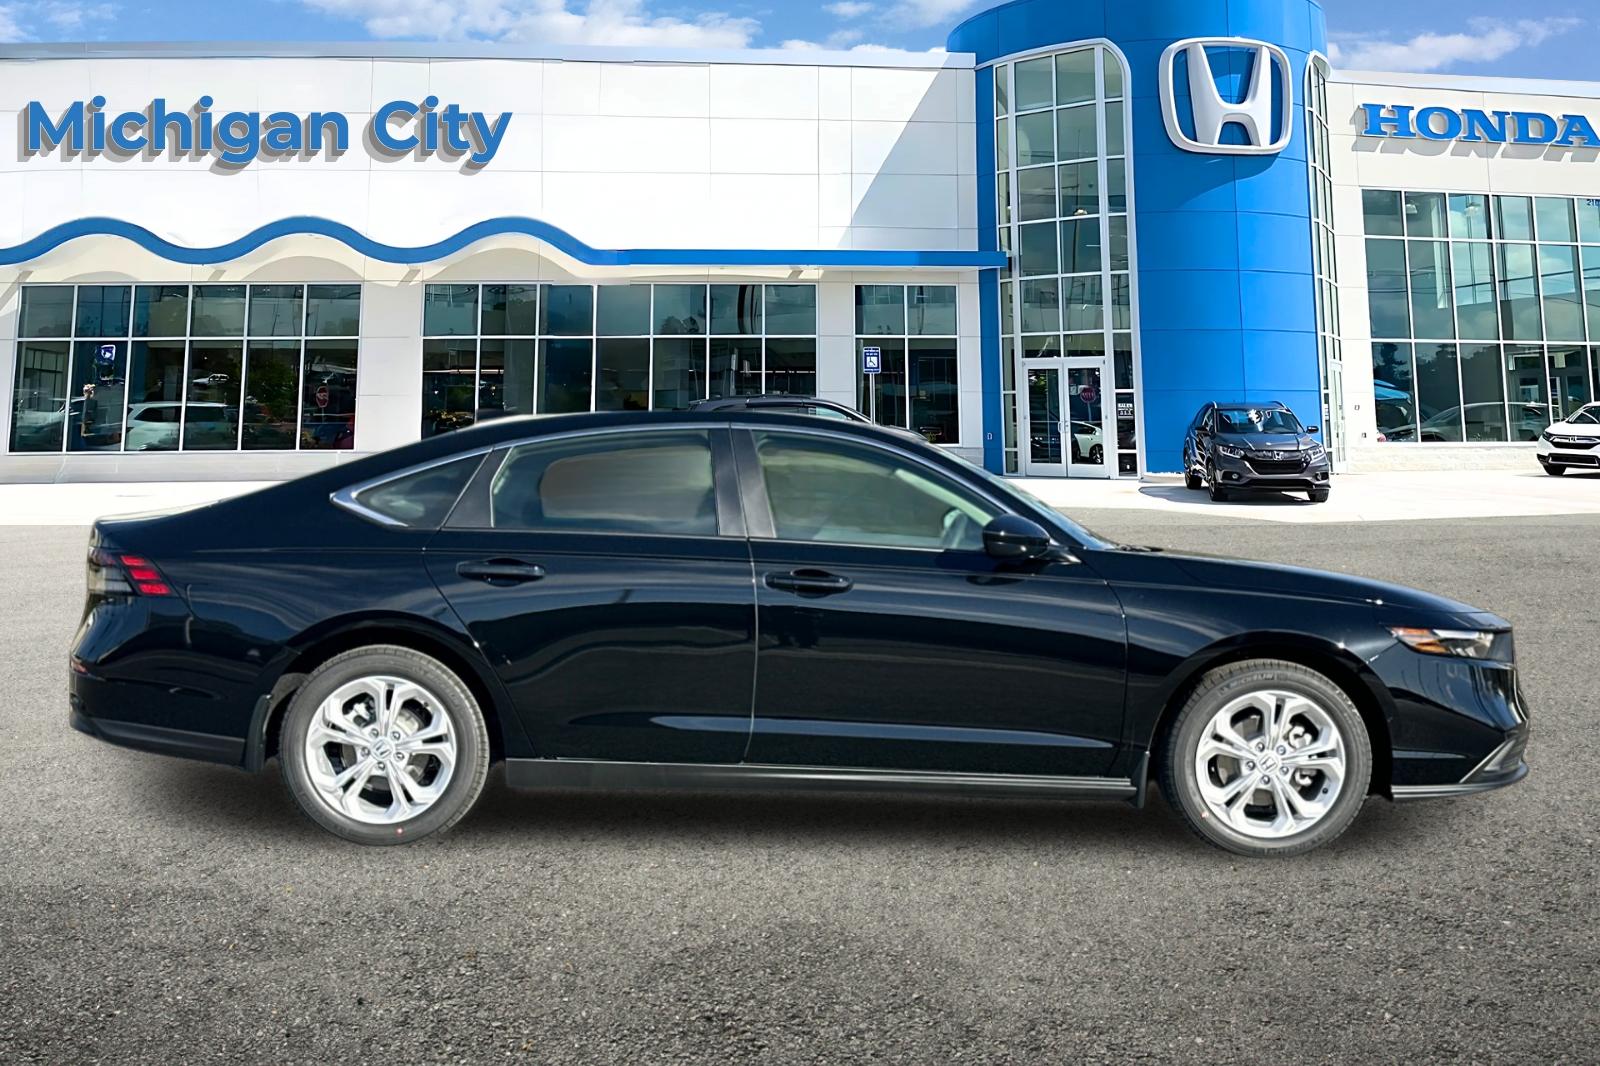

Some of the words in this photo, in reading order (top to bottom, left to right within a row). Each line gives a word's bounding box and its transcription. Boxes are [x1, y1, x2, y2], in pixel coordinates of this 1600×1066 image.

[28, 95, 349, 164] Michigan
[373, 95, 514, 164] City
[1361, 103, 1600, 147] HONDA
